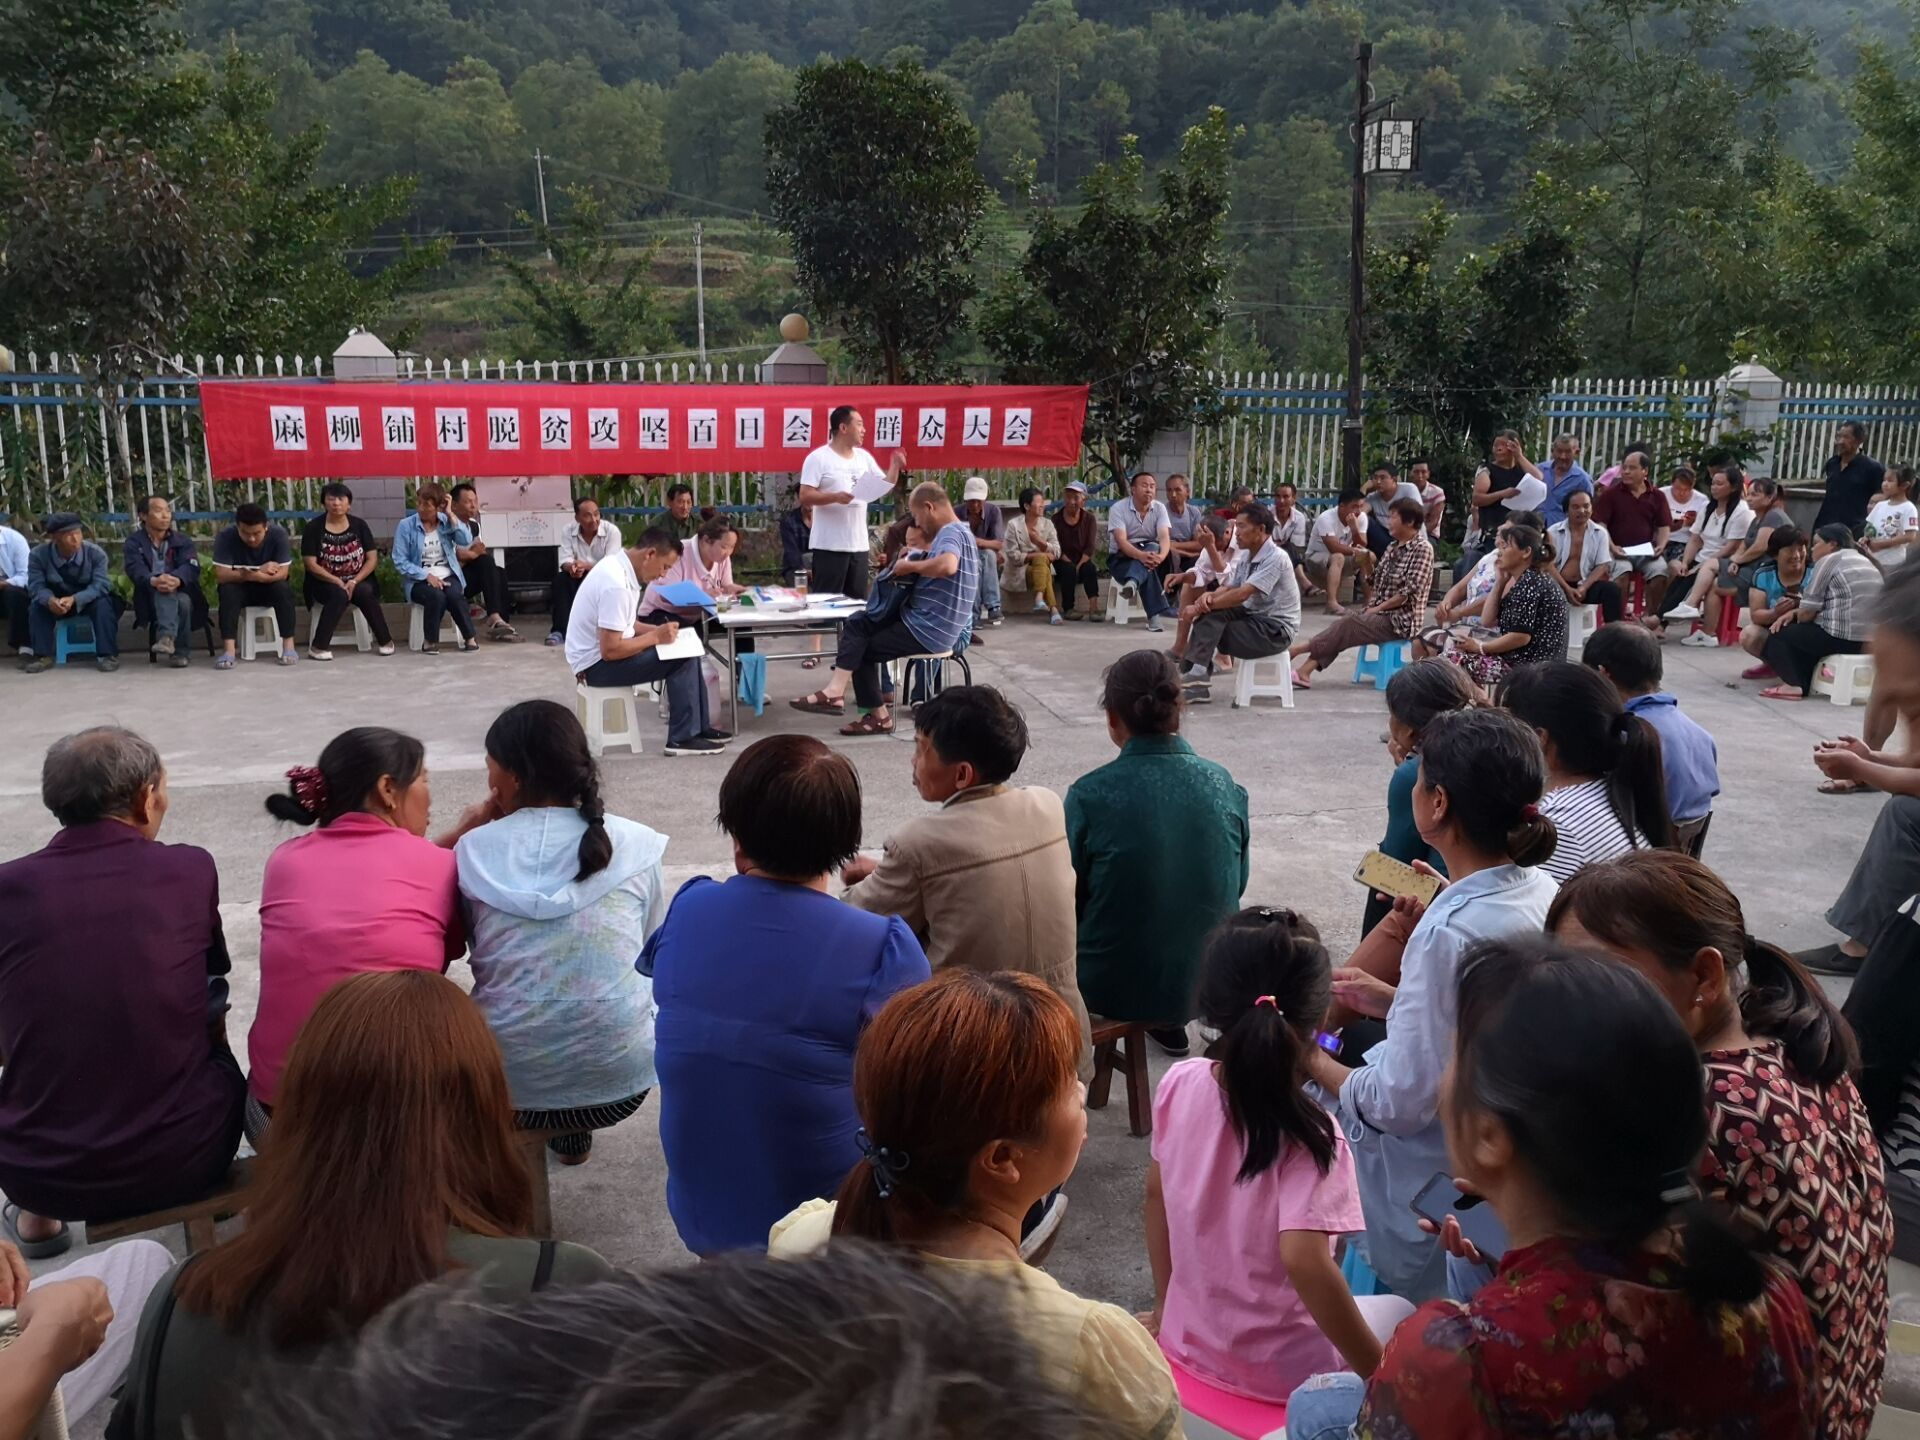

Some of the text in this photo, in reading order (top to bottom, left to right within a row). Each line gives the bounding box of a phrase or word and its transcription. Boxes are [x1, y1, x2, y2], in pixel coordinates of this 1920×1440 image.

[274, 412, 1029, 444] 麻柳铺村脱贫攻坚百日会群众大会
